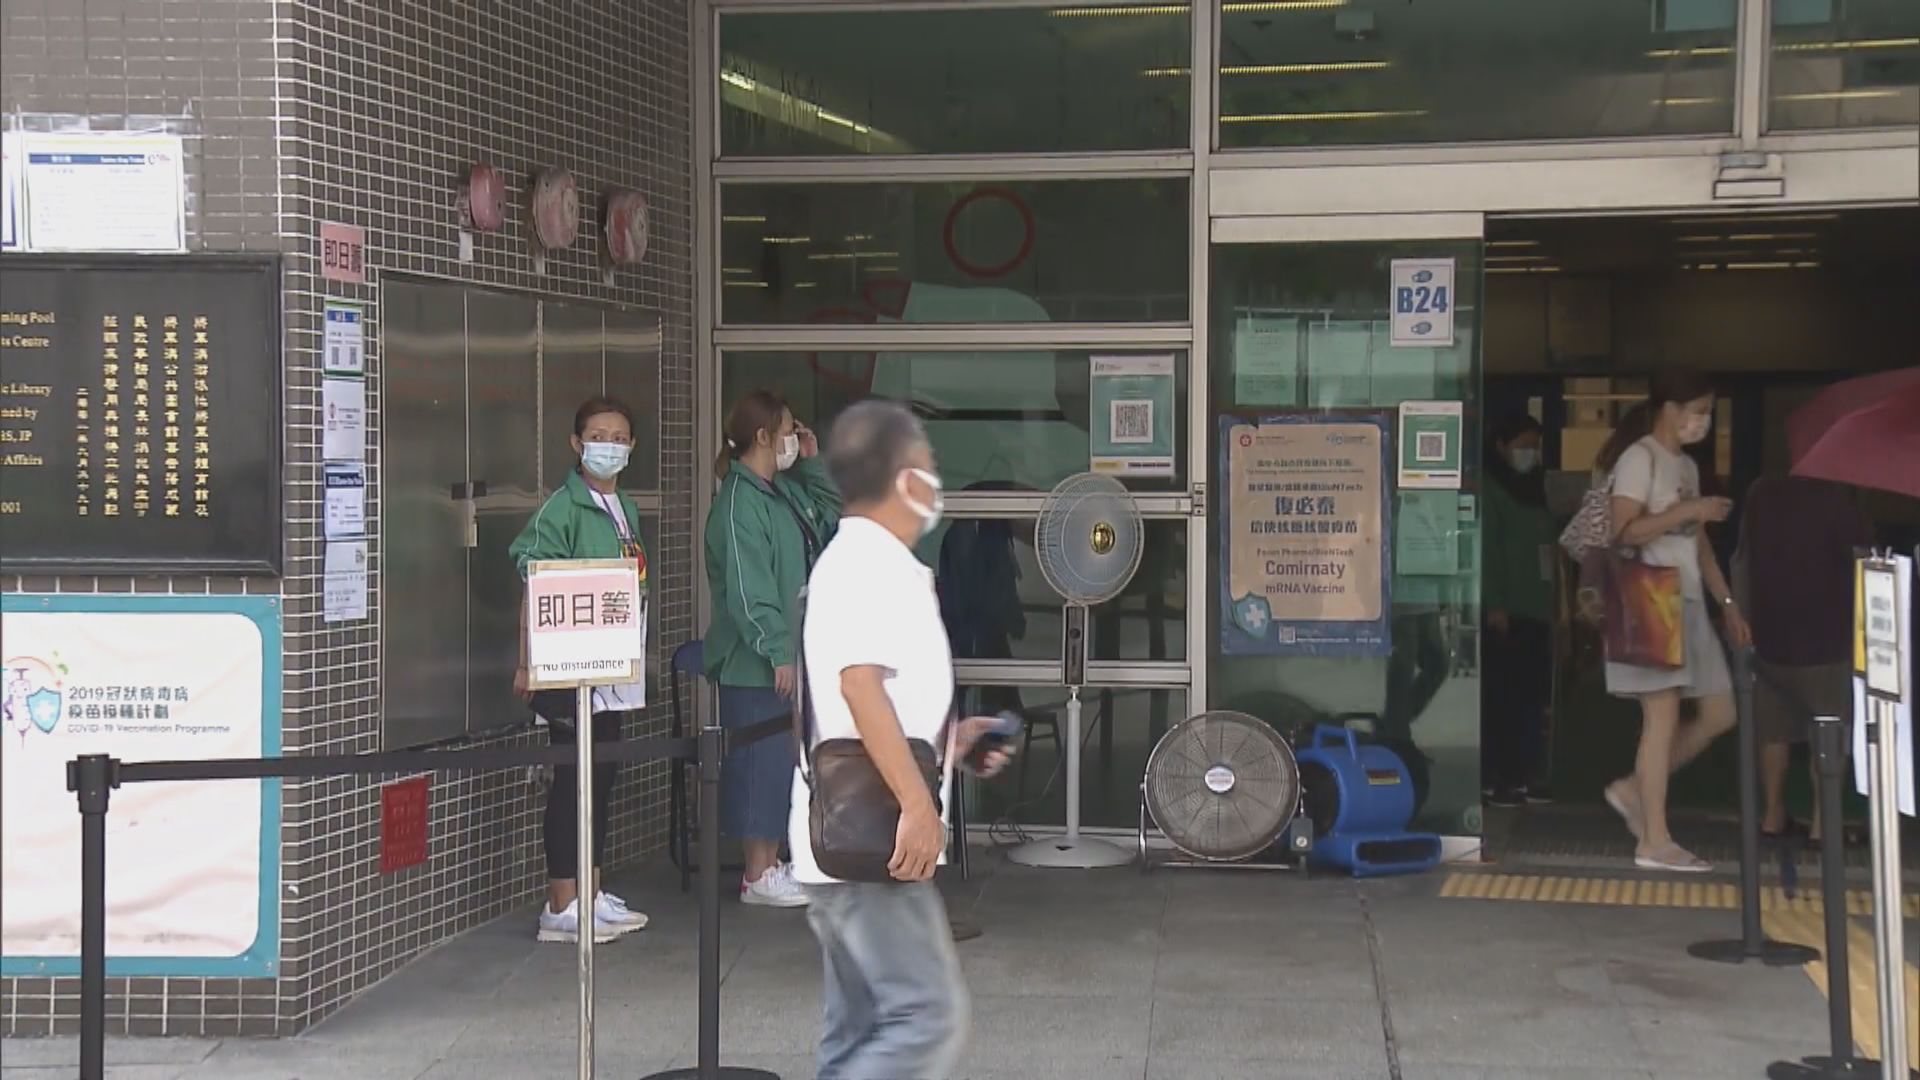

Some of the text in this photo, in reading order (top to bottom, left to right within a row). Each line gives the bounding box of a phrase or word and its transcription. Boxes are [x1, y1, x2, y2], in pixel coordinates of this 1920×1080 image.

[1397, 286, 1448, 313] B24
[30, 311, 55, 324] Pool
[12, 335, 50, 348] Centre
[11, 382, 52, 398] Library
[24, 406, 39, 421] by
[4, 453, 44, 466] Affairs
[1275, 496, 1335, 516] 復必泰
[1265, 560, 1345, 579] Comirnaty
[1265, 582, 1345, 594] mRNA Vaccine
[538, 590, 631, 627] 即日籌
[68, 685, 189, 702] 2019冠狀病毒病
[68, 704, 169, 719] 疫苗接種計劃
[117, 723, 173, 733] Vaccination
[174, 723, 231, 735] Programme
